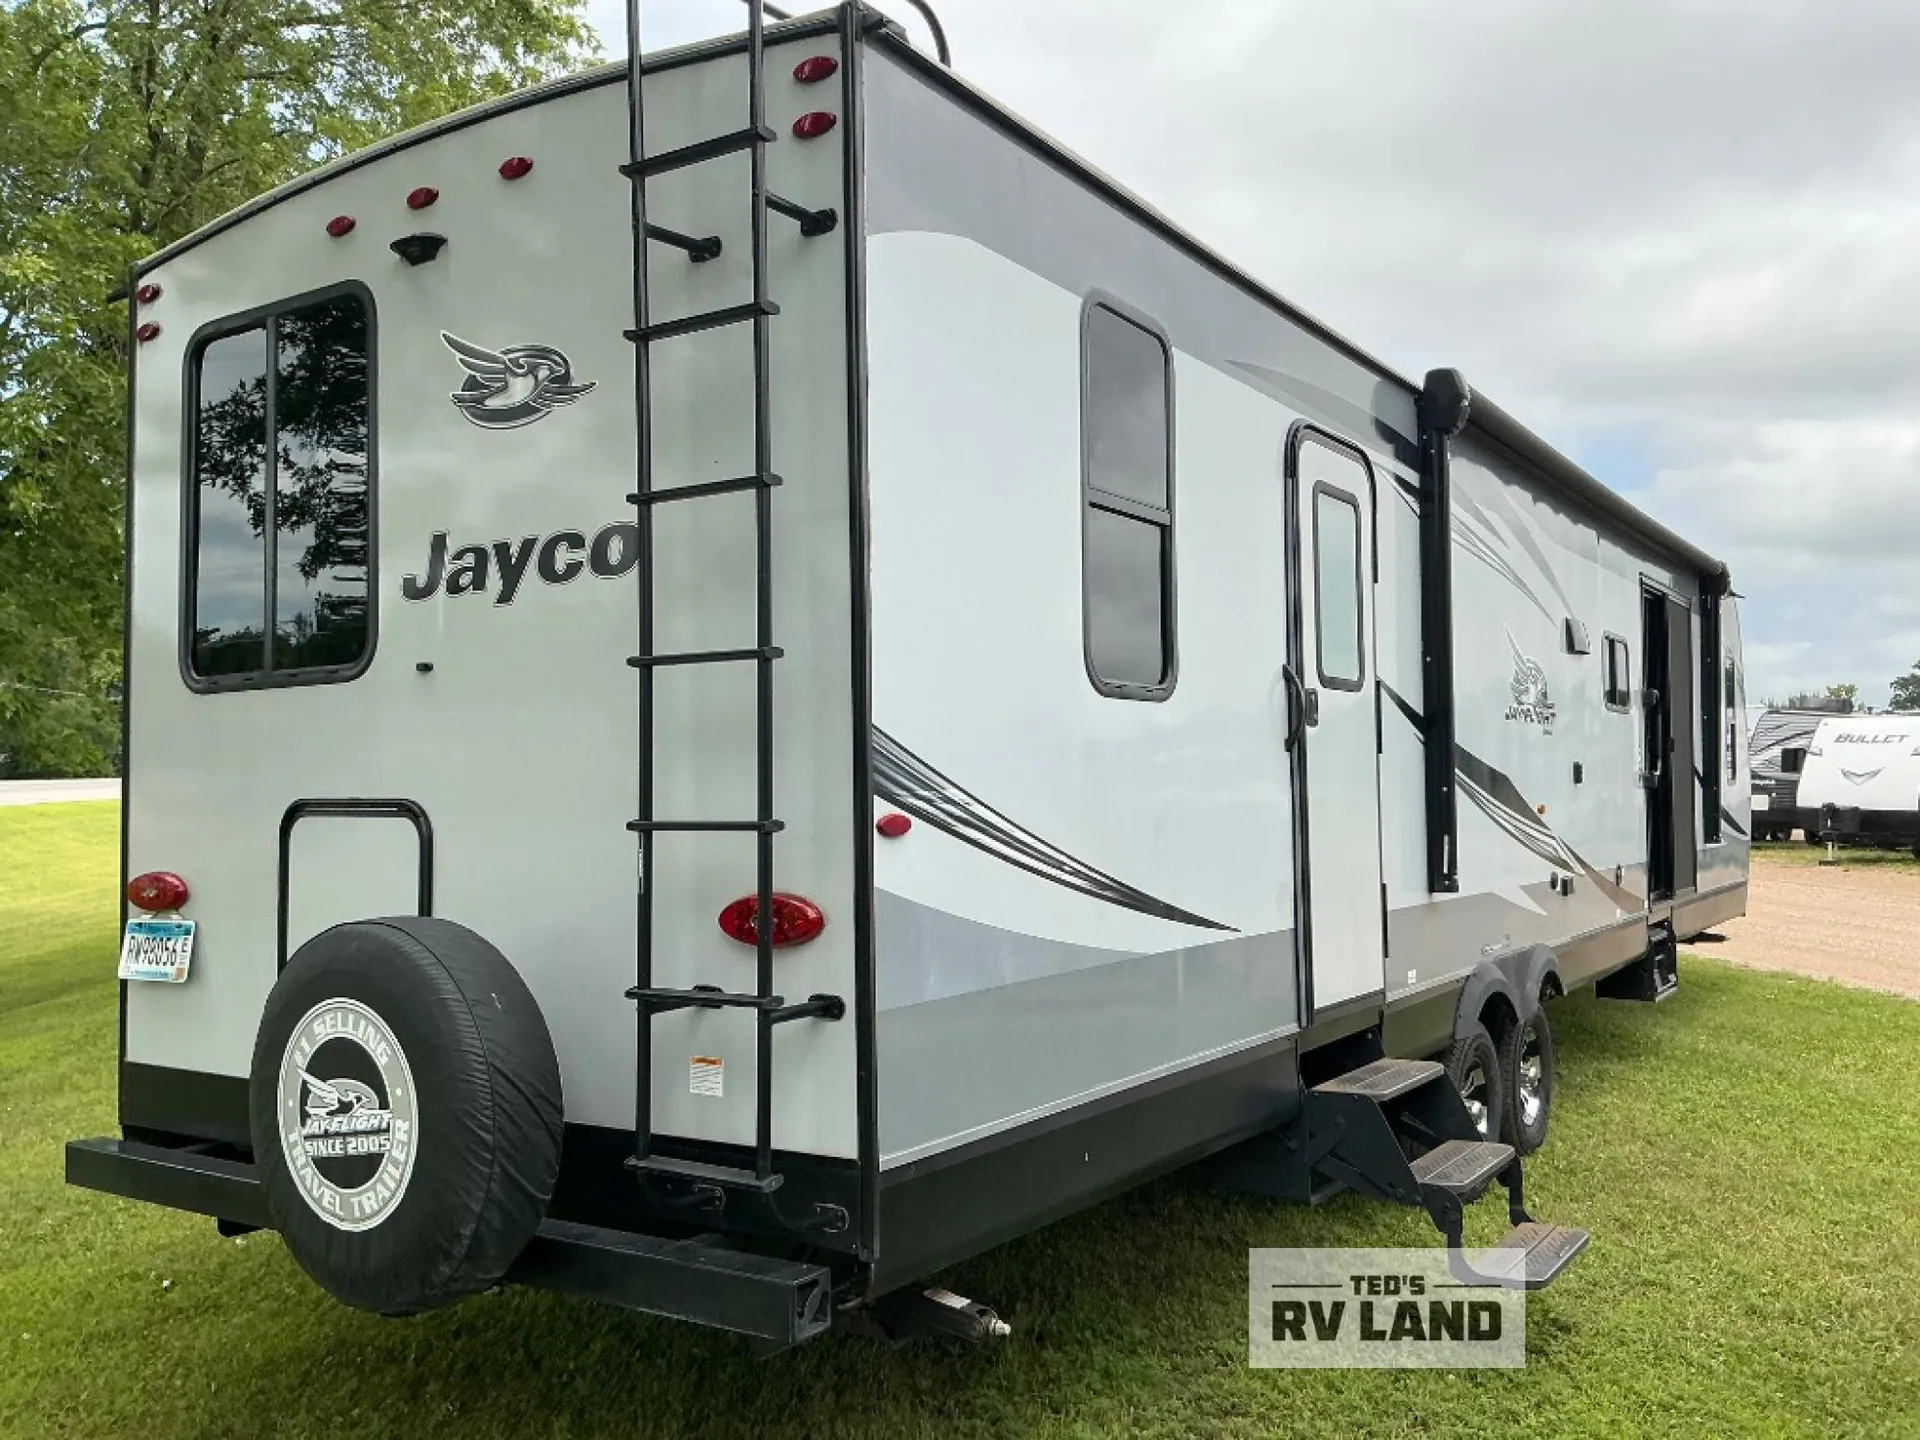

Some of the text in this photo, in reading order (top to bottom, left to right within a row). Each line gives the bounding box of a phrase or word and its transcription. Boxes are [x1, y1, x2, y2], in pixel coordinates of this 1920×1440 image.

[400, 520, 640, 608] Jayco
[1833, 733, 1911, 745] BULLET
[312, 1012, 391, 1067] SELLING
[288, 1119, 410, 1218] TRAVEL TRAILER
[304, 1134, 392, 1157] SINCE 2005
